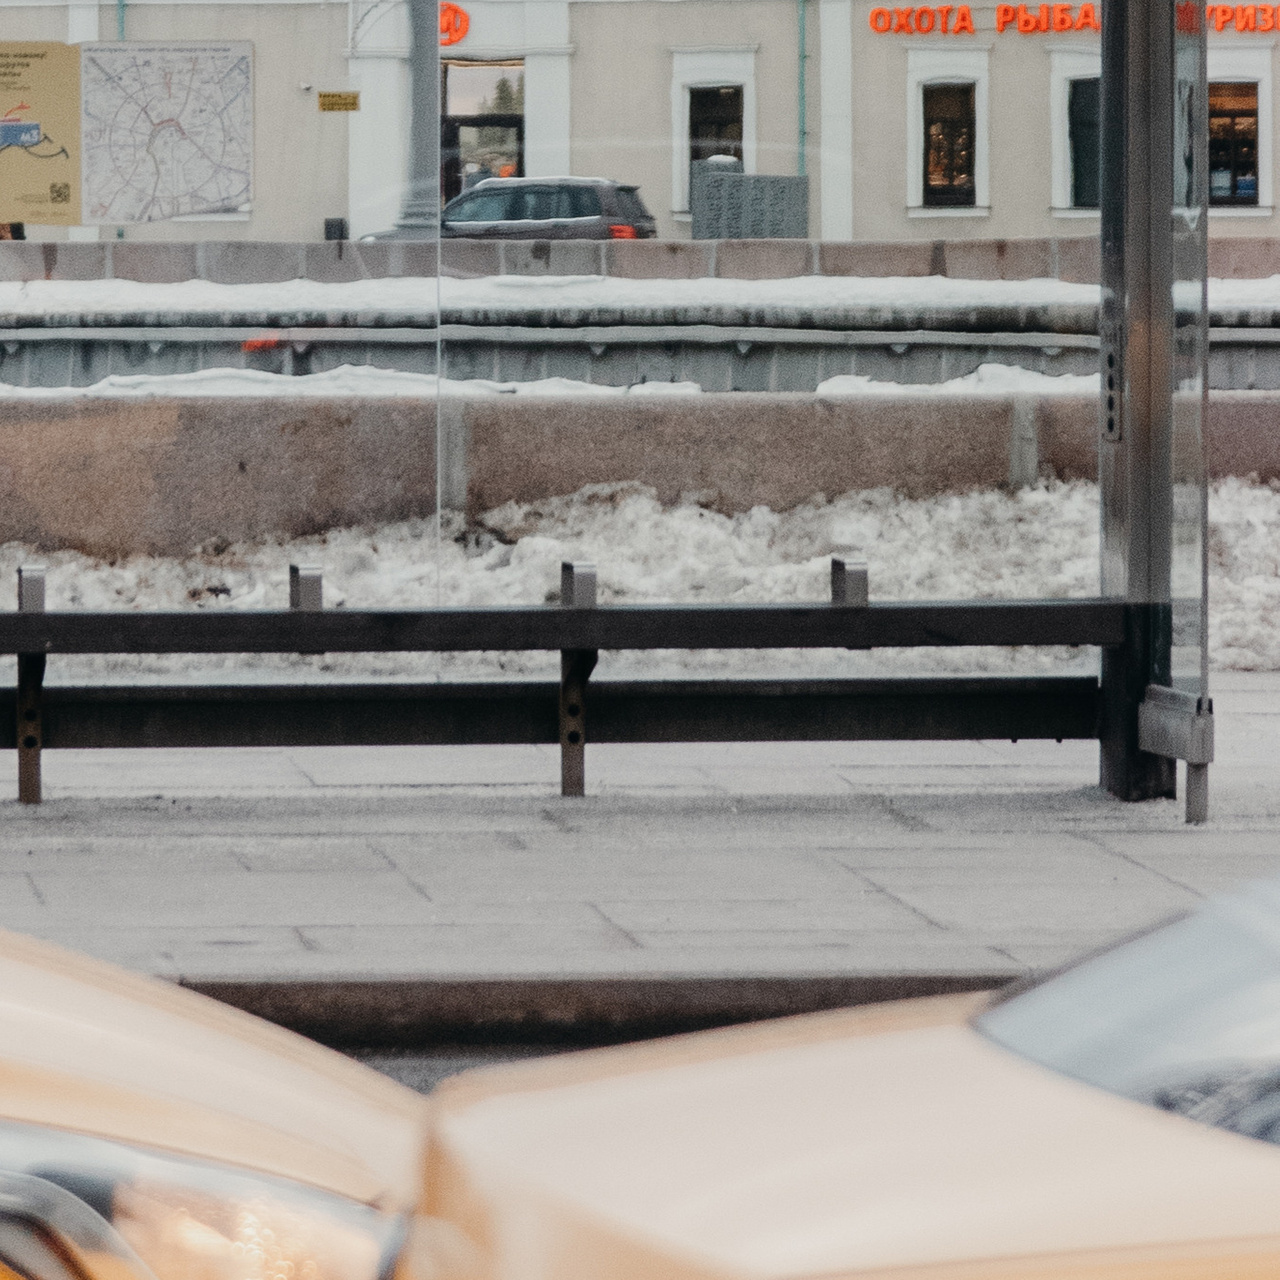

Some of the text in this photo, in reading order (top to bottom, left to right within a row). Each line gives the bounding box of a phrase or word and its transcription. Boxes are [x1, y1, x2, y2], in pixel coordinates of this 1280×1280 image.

[869, 4, 975, 34] ОХОТА
[996, 2, 1102, 34] РЫБА
[1206, 3, 1280, 33] РИЗ
